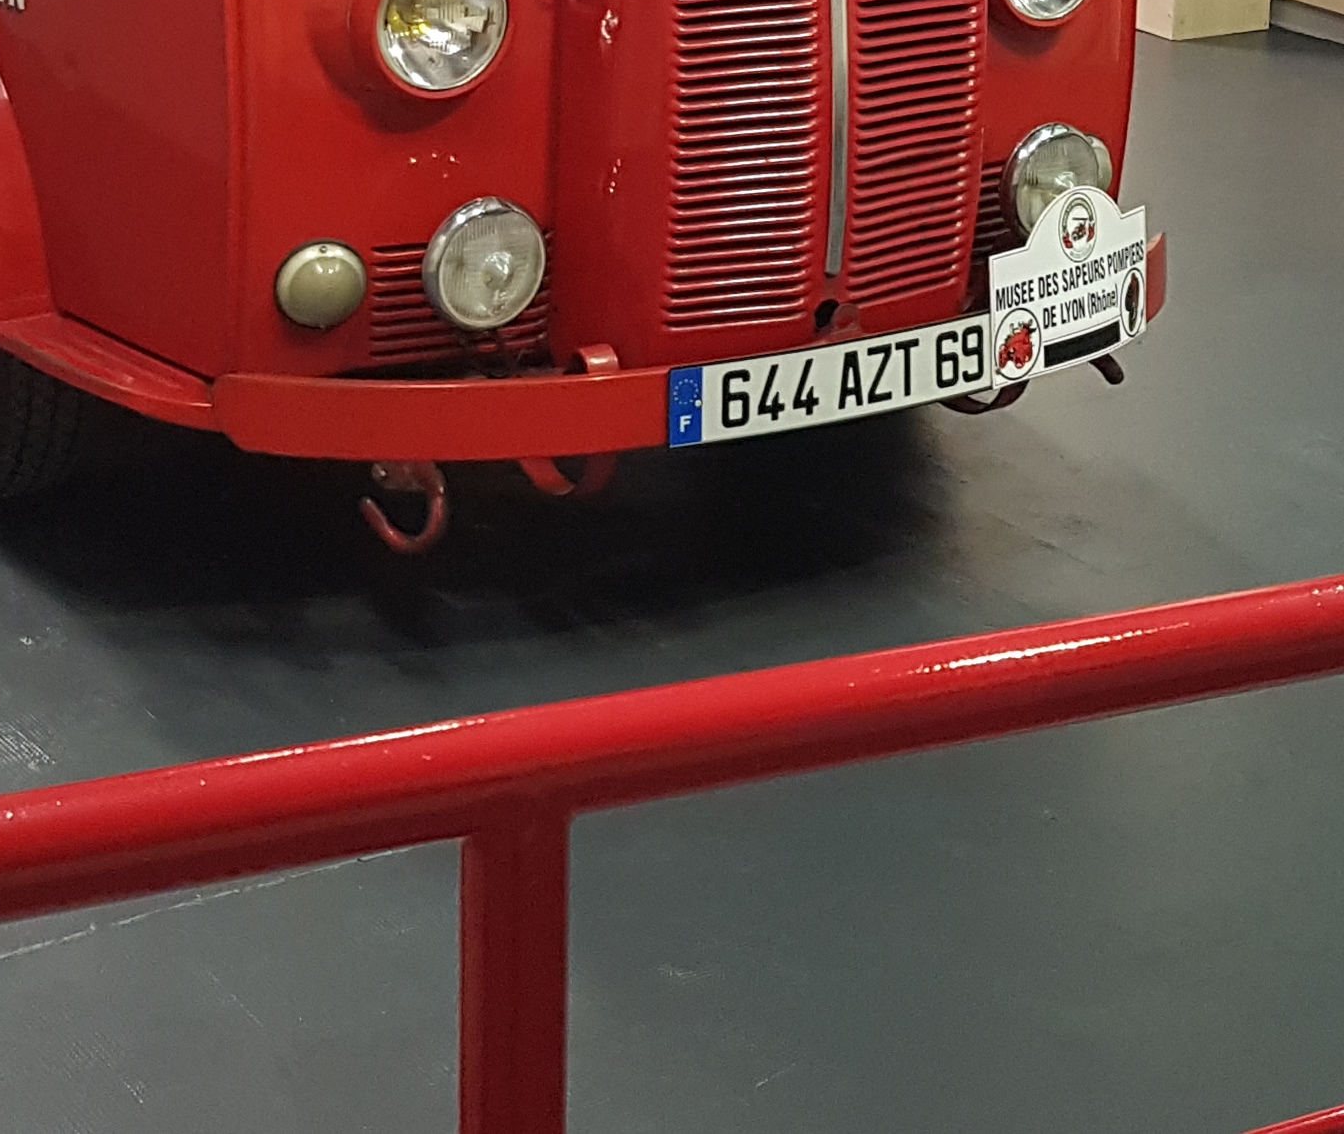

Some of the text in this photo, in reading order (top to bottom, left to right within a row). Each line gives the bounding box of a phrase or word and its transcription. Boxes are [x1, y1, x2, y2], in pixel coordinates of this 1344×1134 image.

[995, 240, 1144, 312] MUSEE DES SAPEURS POMPIERS
[1042, 306, 1057, 330] DE
[1060, 297, 1085, 325] LYON
[721, 325, 984, 429] 644 AZT 69
[679, 415, 693, 433] F
